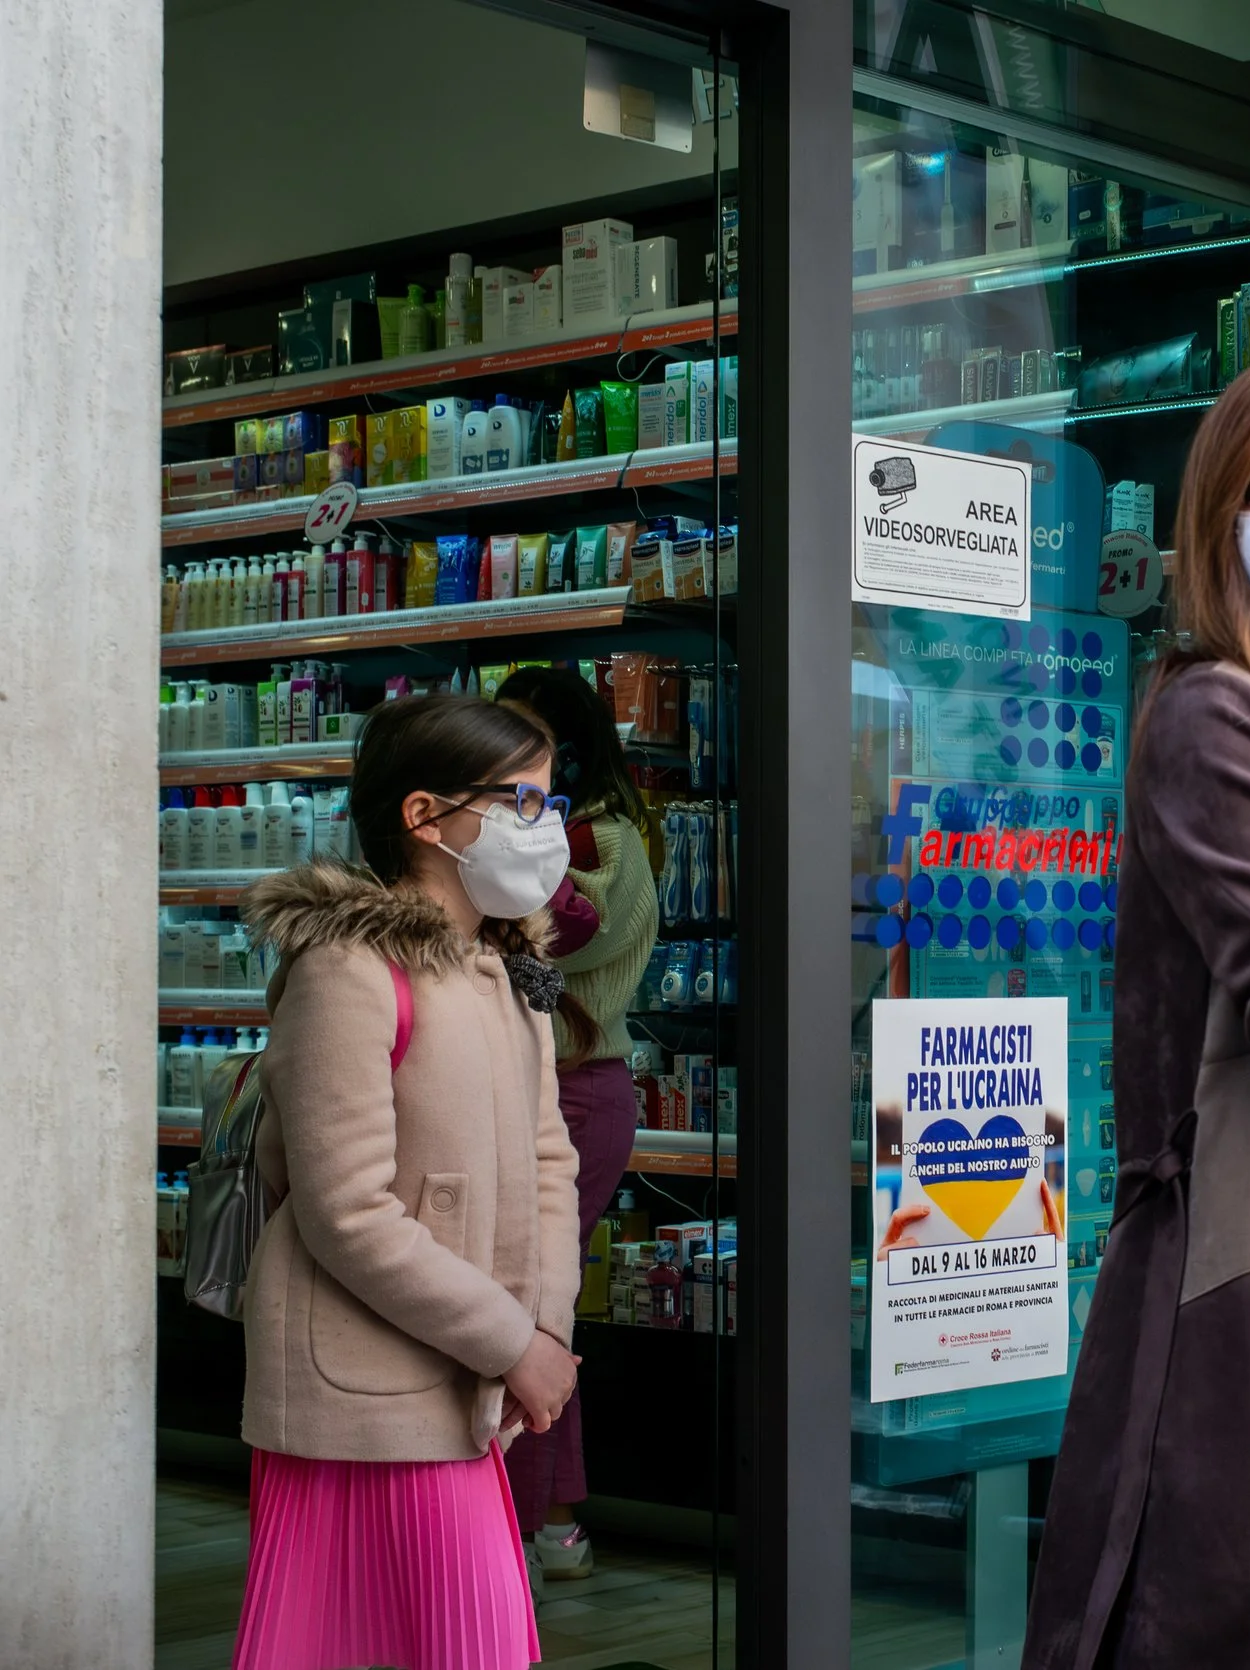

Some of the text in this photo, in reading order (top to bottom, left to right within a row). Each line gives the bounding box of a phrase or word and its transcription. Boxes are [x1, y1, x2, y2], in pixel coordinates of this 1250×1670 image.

[311, 502, 349, 528] 2+1
[966, 500, 1018, 525] AREA
[864, 516, 1018, 557] VIDEOSORVEGLIATA
[1108, 548, 1133, 559] PROMO
[1099, 557, 1149, 596] 2+1
[899, 640, 917, 655] LA
[920, 641, 960, 659] LINEA
[921, 1024, 1032, 1066] FARMACISTI
[907, 1068, 1043, 1112] PER L'UCRAINA
[891, 1134, 1055, 1156] IL POPOLO UCRAINO HA BISOGNO
[909, 1156, 1041, 1178] ANCHE DEL NOSTRO AIUTO
[912, 1244, 1036, 1275] DAL 9 AL 16 MARZO
[887, 1281, 1059, 1308] RACCOLTA DI MEDICINALI E MATERIALI SANITARI
[894, 1296, 1053, 1323] IN TUTTE LE FARMACIE DI ROMA E PROVINCIA
[949, 1328, 1012, 1343] Croce Rossa Italiana
